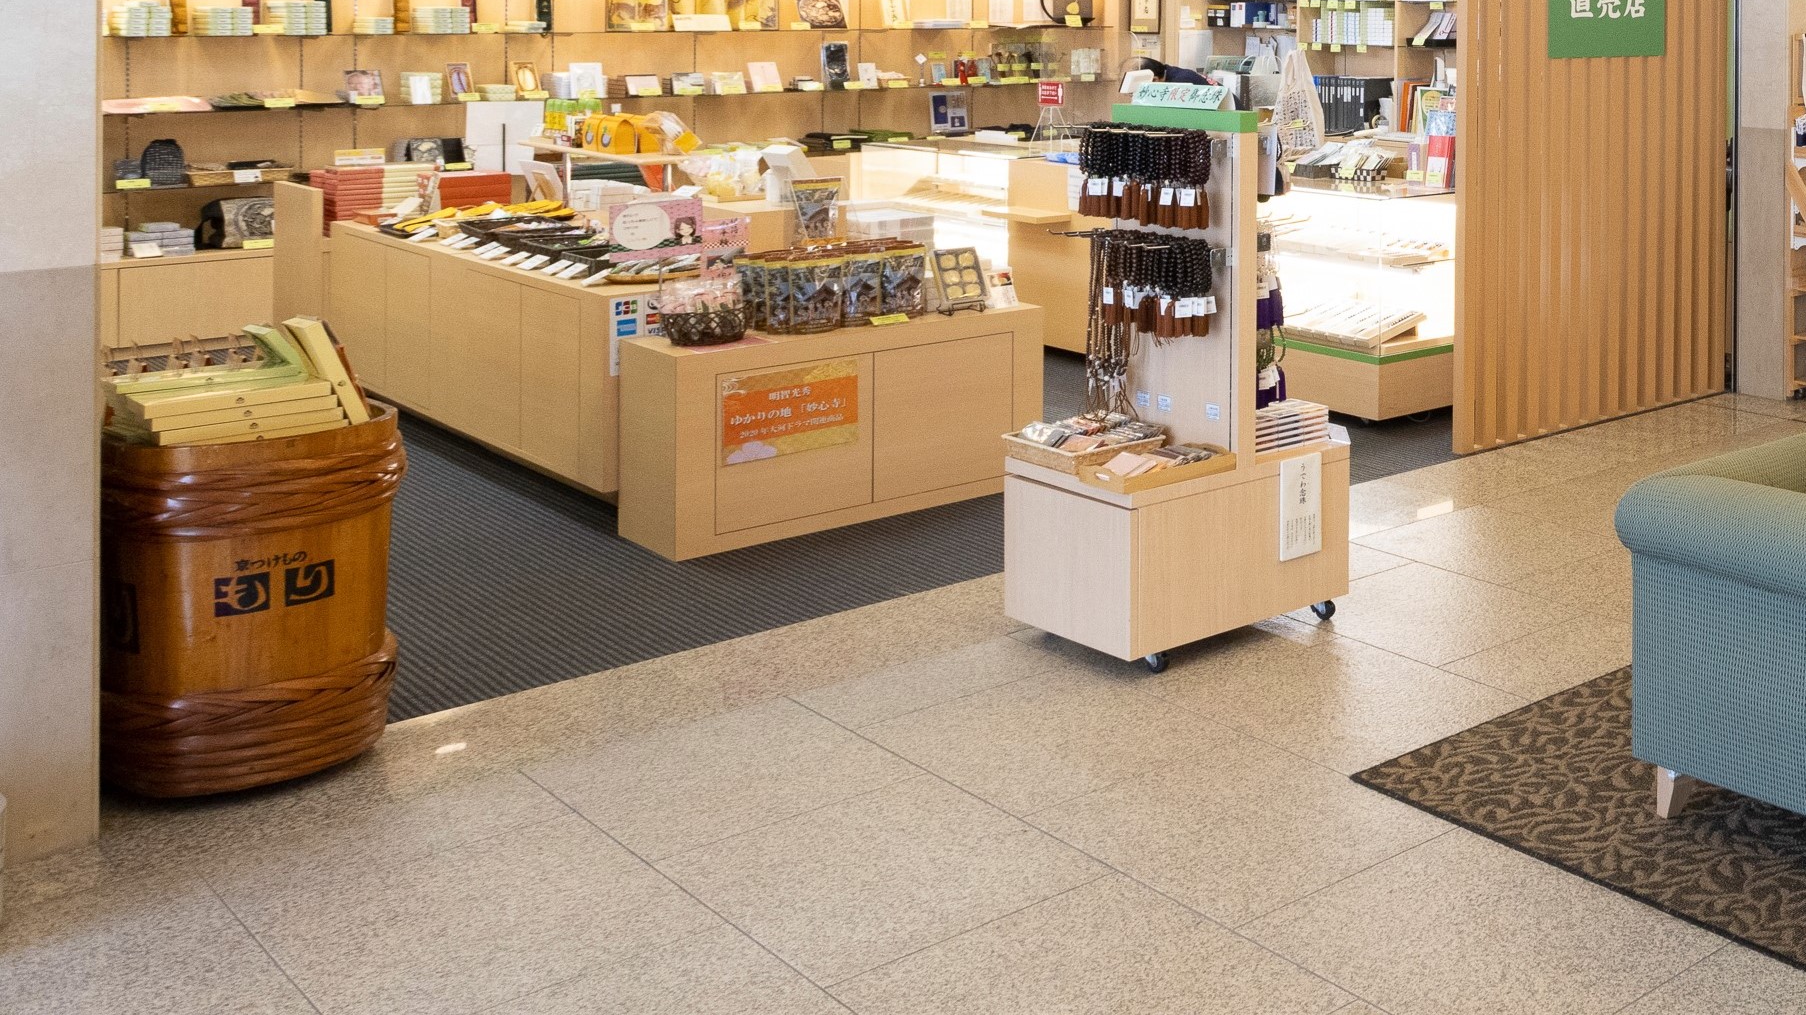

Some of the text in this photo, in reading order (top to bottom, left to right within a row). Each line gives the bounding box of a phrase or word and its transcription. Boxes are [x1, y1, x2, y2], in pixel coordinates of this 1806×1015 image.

[615, 299, 638, 316] JCB
[768, 385, 812, 402] 明智光秀
[235, 550, 308, 572] 京つけもの
[215, 559, 335, 617] もり
